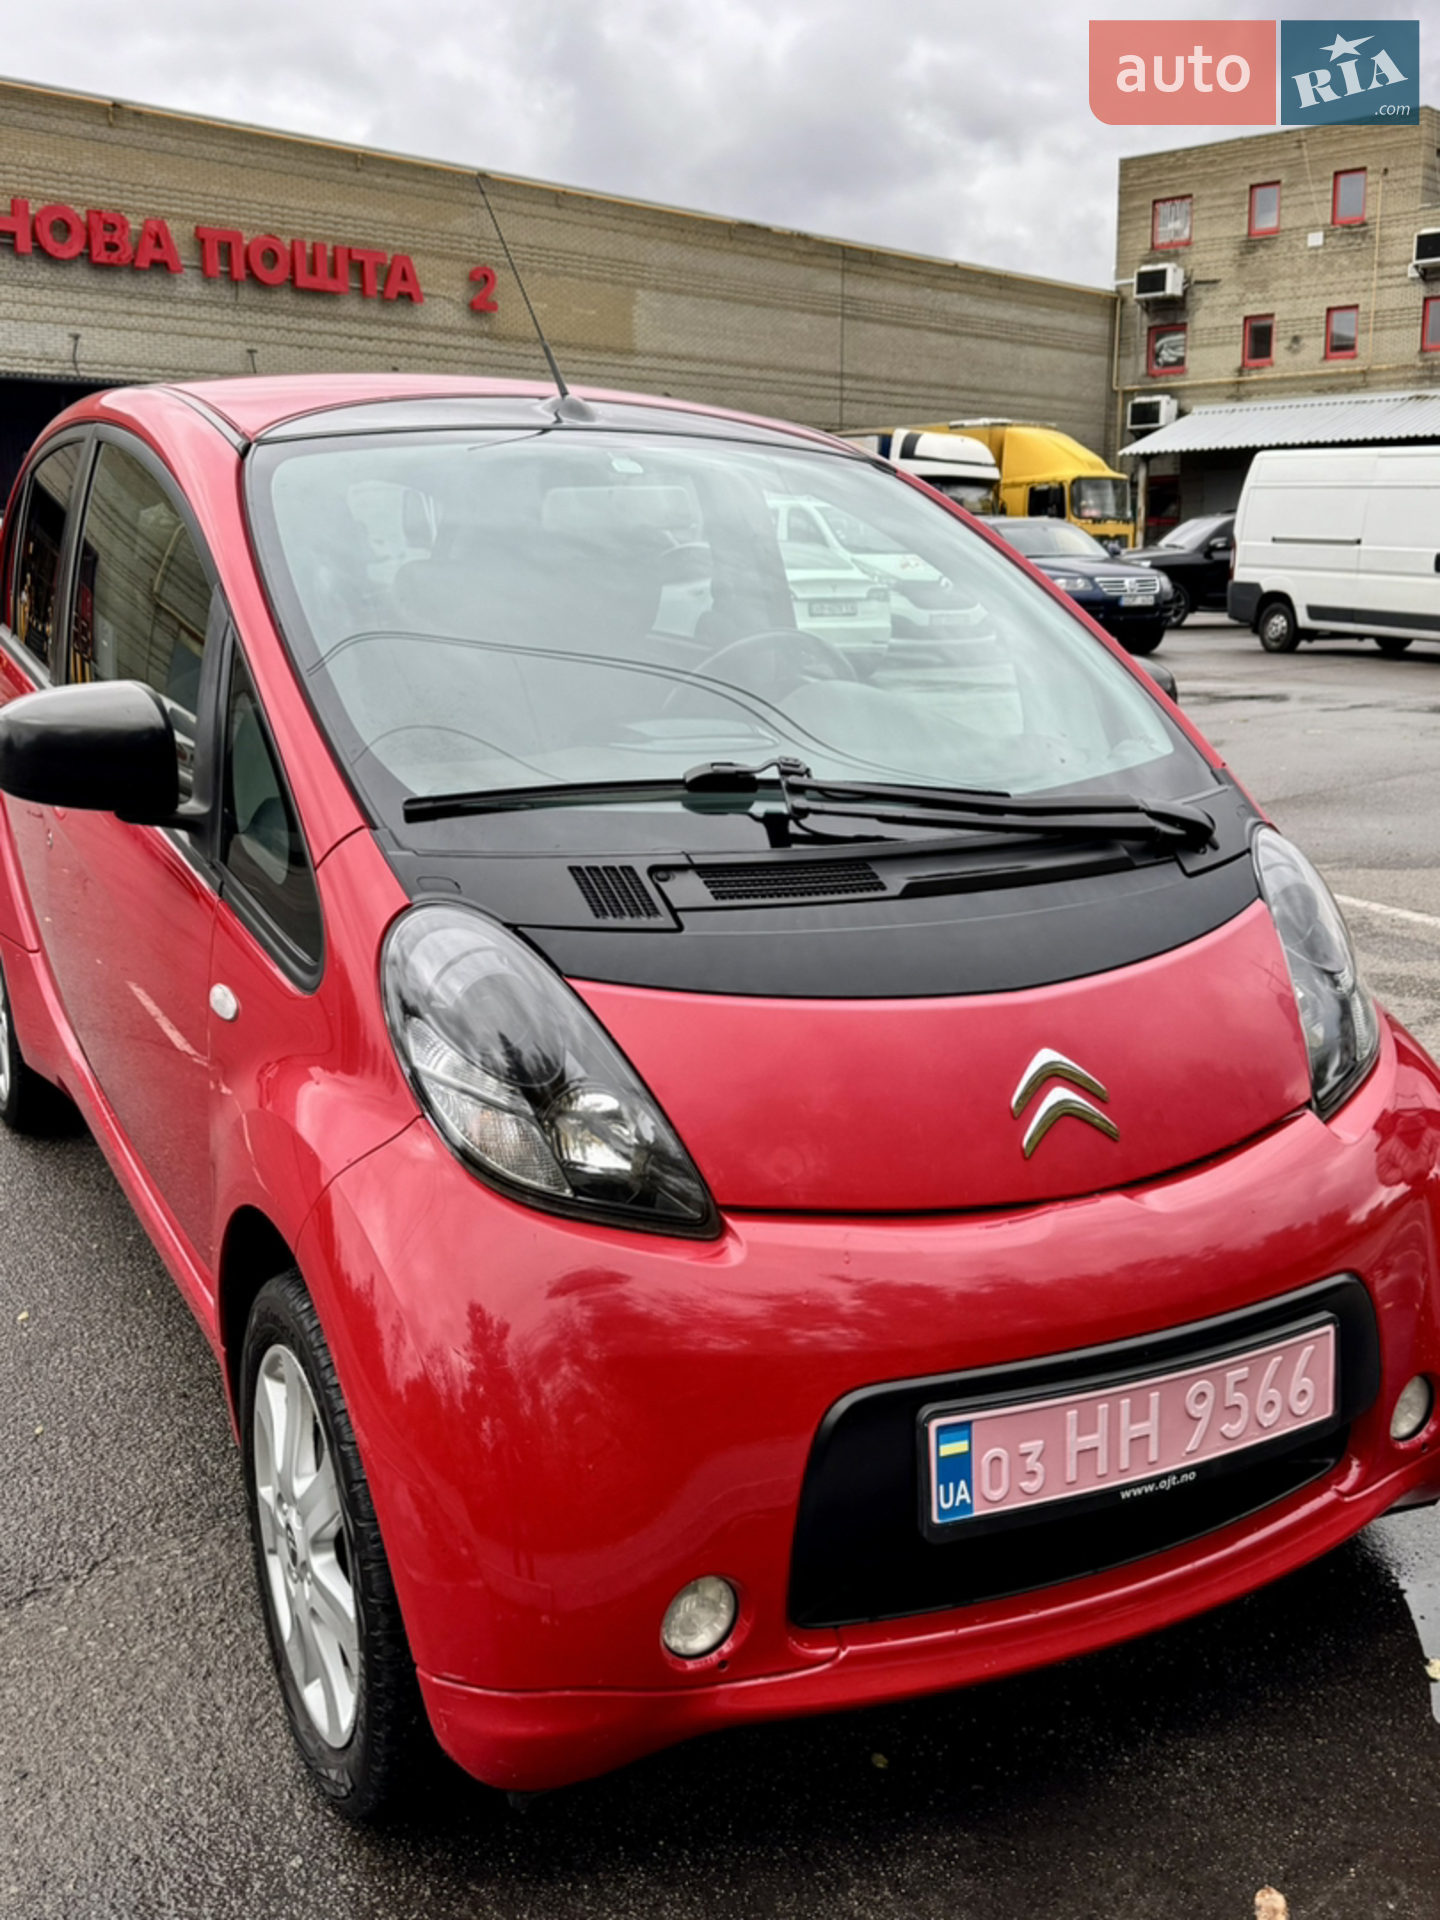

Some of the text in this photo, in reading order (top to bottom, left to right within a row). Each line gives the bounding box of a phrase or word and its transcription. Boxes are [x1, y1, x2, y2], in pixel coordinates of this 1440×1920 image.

[195, 225, 425, 304] ПОШТА
[468, 265, 499, 313] 2
[981, 1344, 1316, 1503] 03 HH 9566
[938, 1482, 971, 1511] UA
[1119, 1469, 1198, 1501] www.ojt.no
